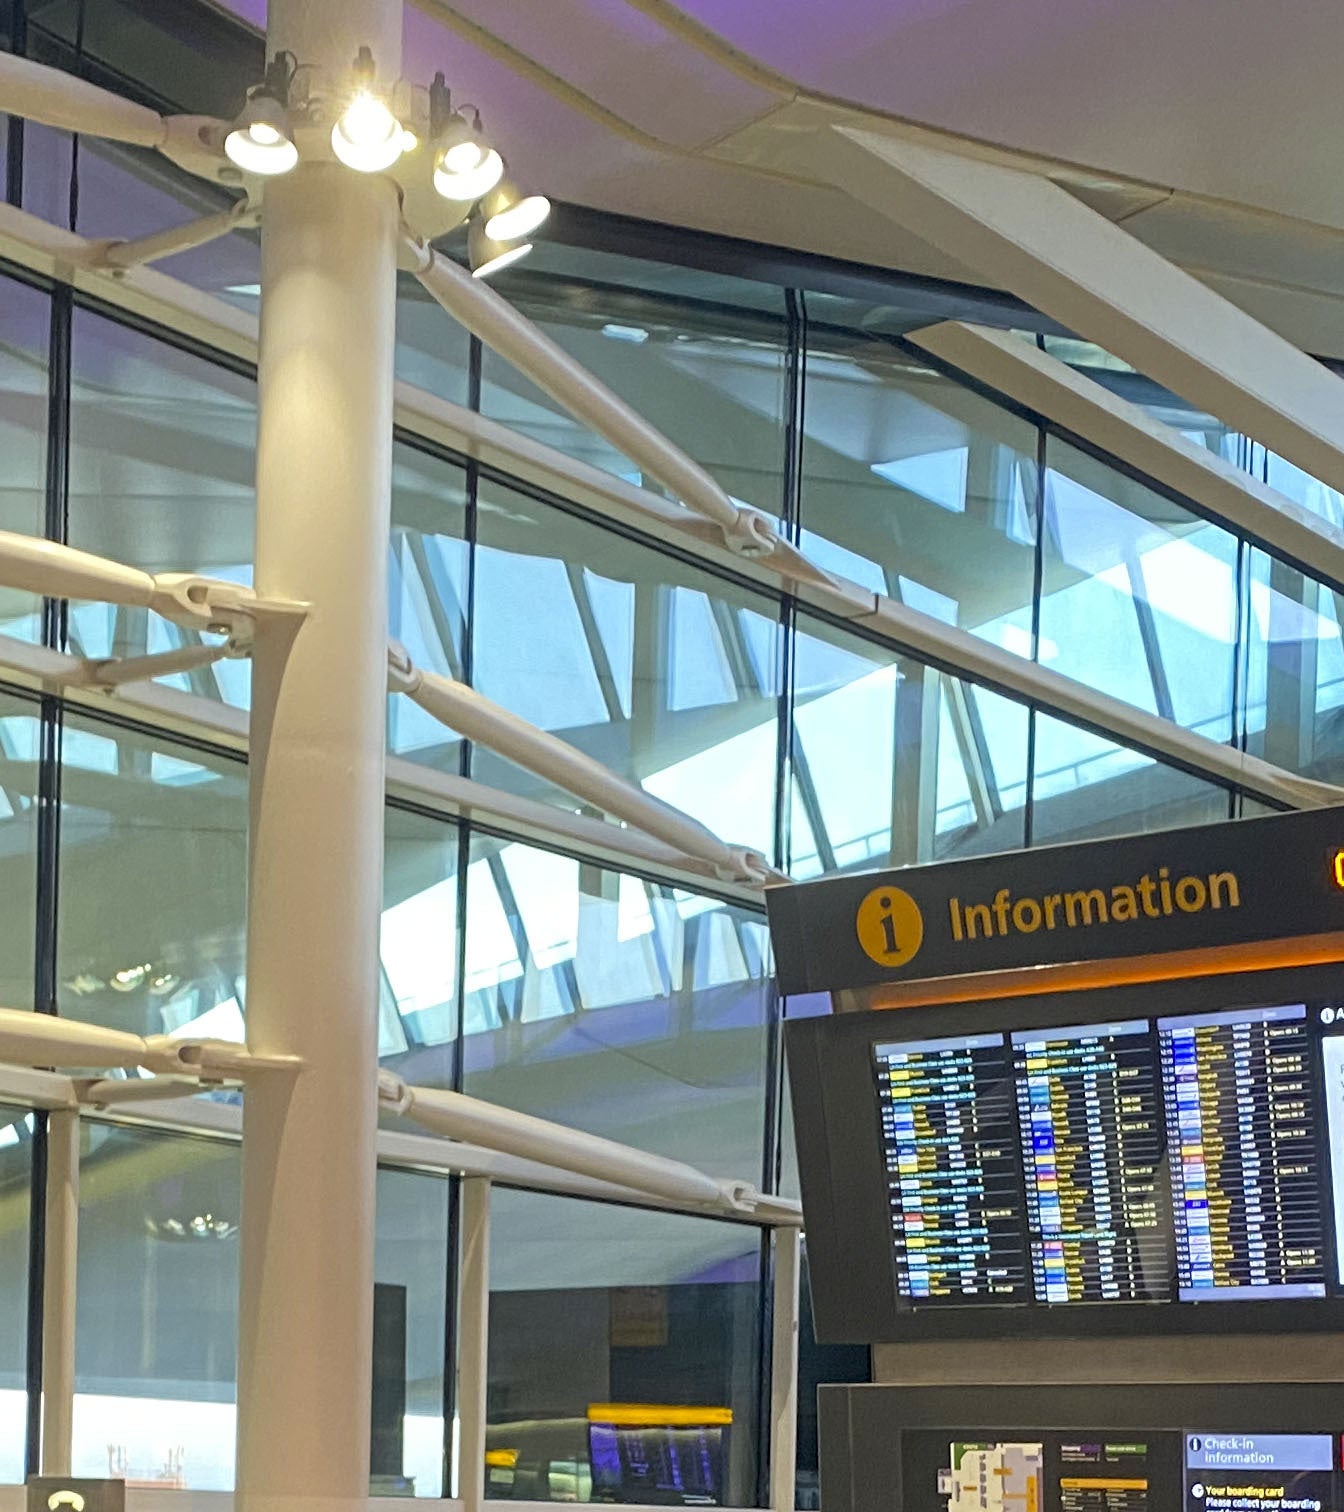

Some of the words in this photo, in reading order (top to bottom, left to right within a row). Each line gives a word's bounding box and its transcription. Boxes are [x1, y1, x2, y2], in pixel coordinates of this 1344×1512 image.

[950, 868, 1239, 942] Information
[1204, 1438, 1254, 1450] Check-in
[1206, 1486, 1225, 1496] Your
[1227, 1487, 1264, 1498] boarding
[1265, 1487, 1284, 1497] card
[1206, 1497, 1231, 1508] Please
[1232, 1498, 1260, 1509] collect
[1260, 1500, 1280, 1510] your
[1281, 1499, 1321, 1512] boarding
